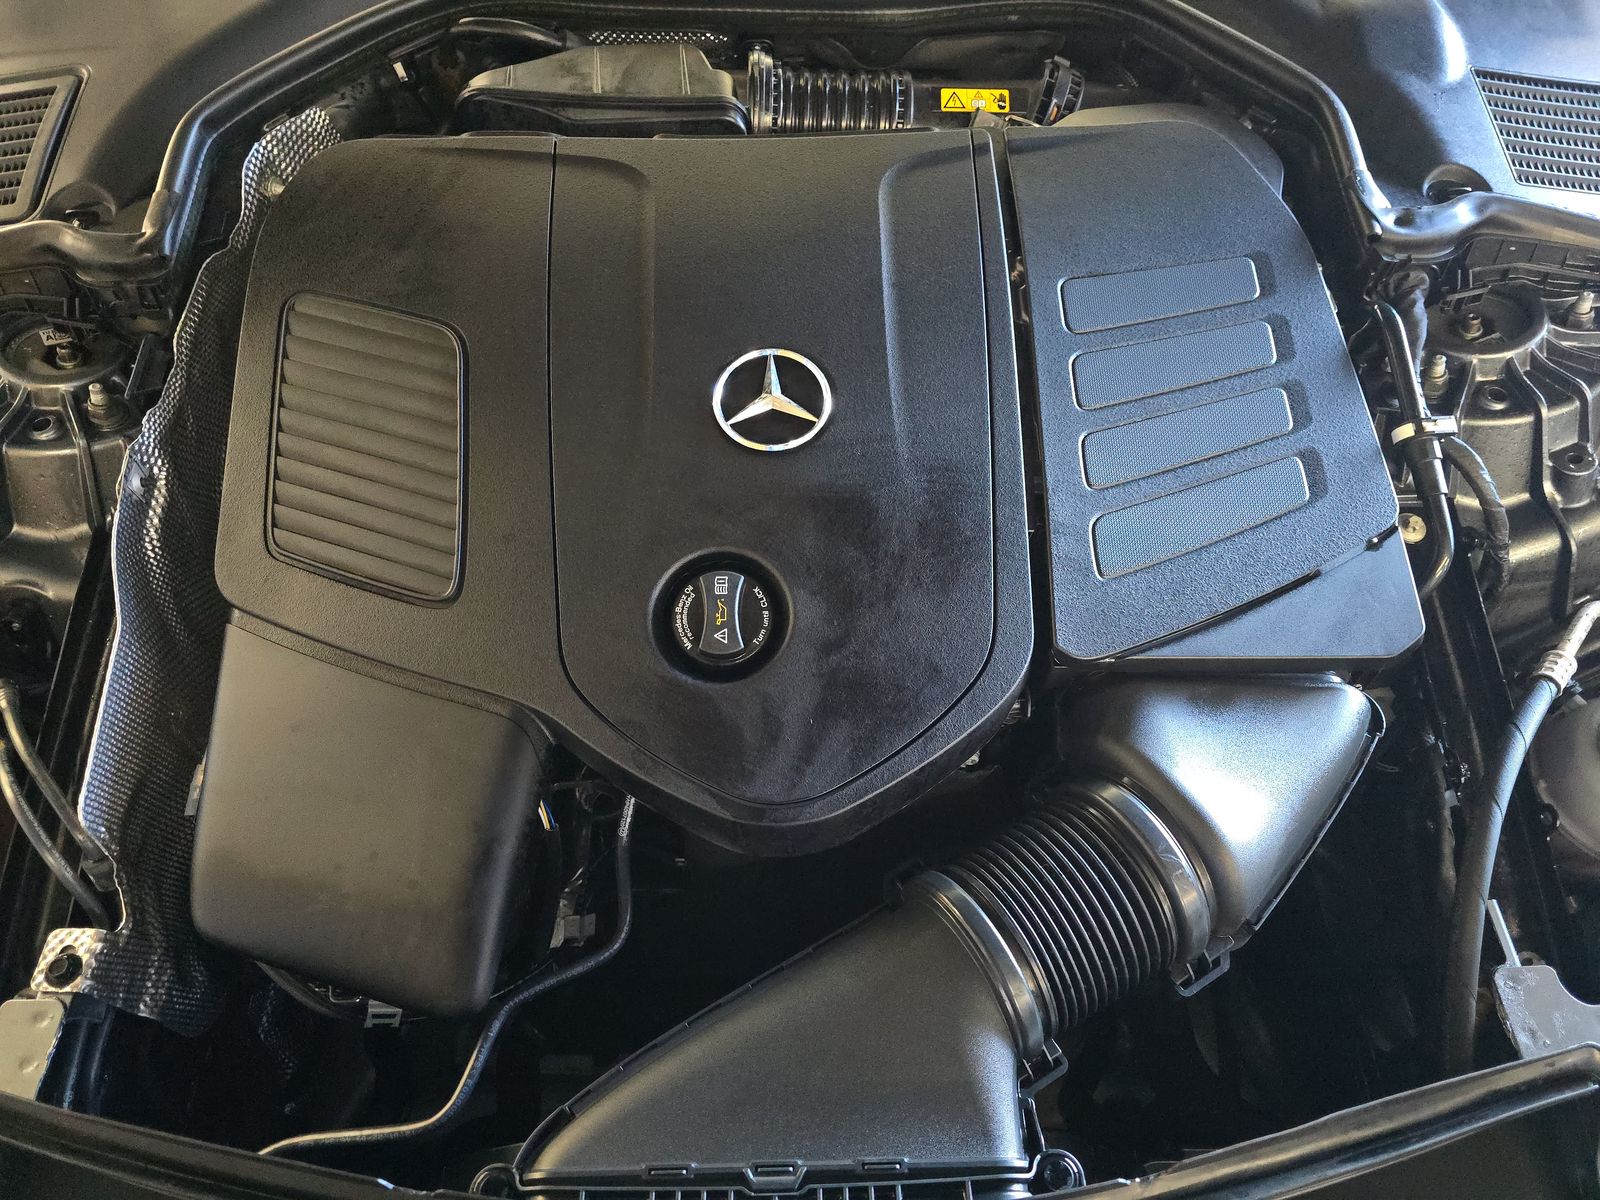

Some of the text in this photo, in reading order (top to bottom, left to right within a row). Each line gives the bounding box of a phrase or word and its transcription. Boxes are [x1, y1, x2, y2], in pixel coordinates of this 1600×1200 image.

[752, 586, 767, 608] CLICK
[675, 584, 694, 650] Mercedes-Benz Oil
[682, 592, 695, 640] recommended
[752, 629, 766, 645] Turn
